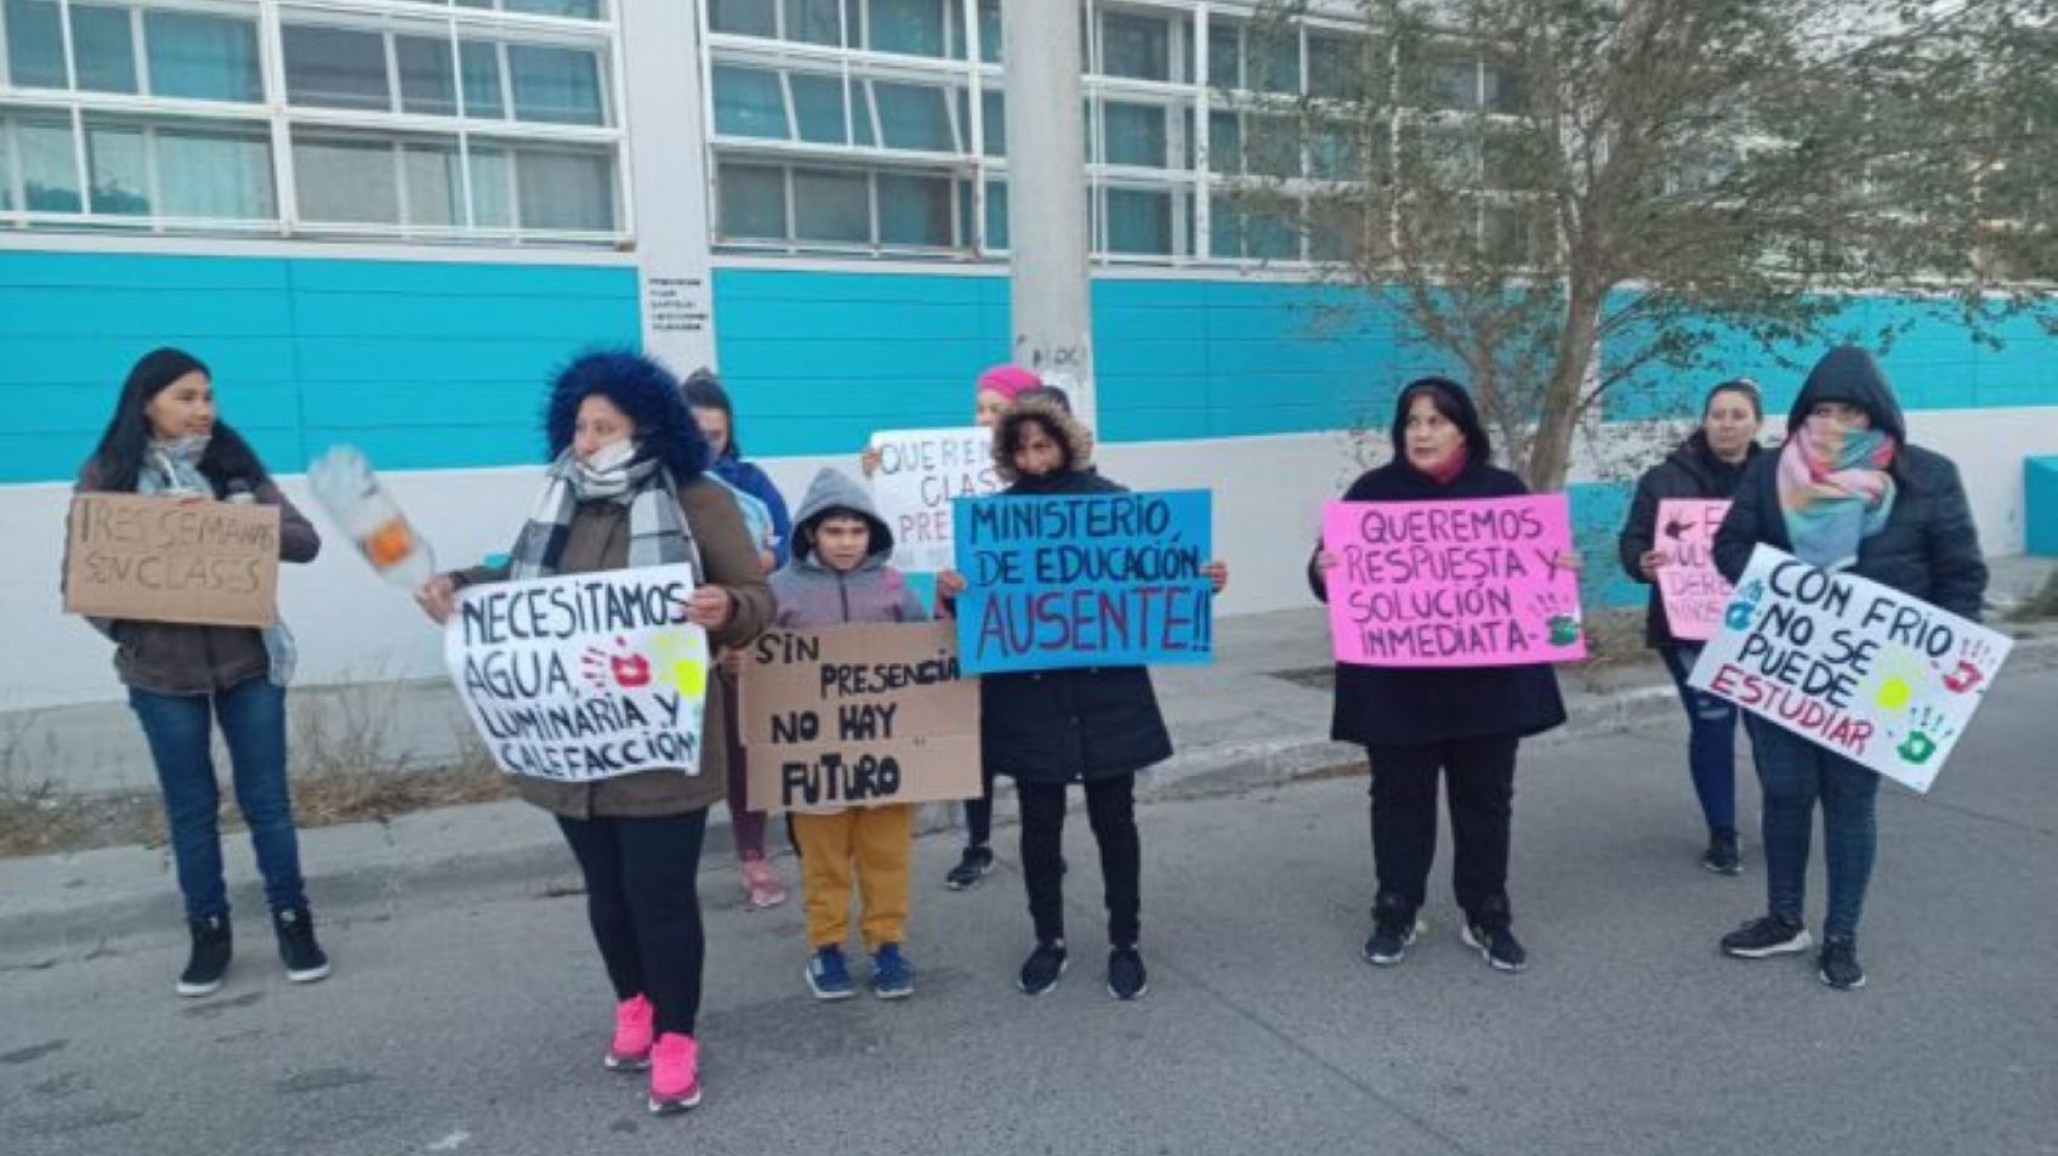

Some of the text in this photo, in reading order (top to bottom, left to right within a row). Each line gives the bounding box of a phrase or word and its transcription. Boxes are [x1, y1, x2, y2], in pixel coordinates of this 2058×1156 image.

[921, 467, 997, 508] CLAS
[897, 510, 951, 544] PRE
[969, 494, 1171, 545] MINISTERIO
[1360, 507, 1544, 545] QUEREMOS
[137, 553, 260, 593] CLASES
[973, 532, 1202, 587] DE EDUCACIÓN
[1343, 543, 1560, 586] RESPUESTA Y
[461, 581, 690, 646] NECESITAMOS
[976, 585, 1211, 661] AUSENTE!!
[1349, 579, 1514, 624] SOLUCIÓN
[1767, 558, 1954, 659] CON FRIO
[755, 632, 820, 664] SIN
[1756, 602, 1881, 677] NO SE
[1736, 631, 1859, 711] PUEDE
[477, 690, 681, 742] LUMINARIA Y
[770, 702, 898, 744] NO HAY
[1709, 662, 1874, 756] ESTUDIAR
[781, 752, 903, 806] FUTURO
